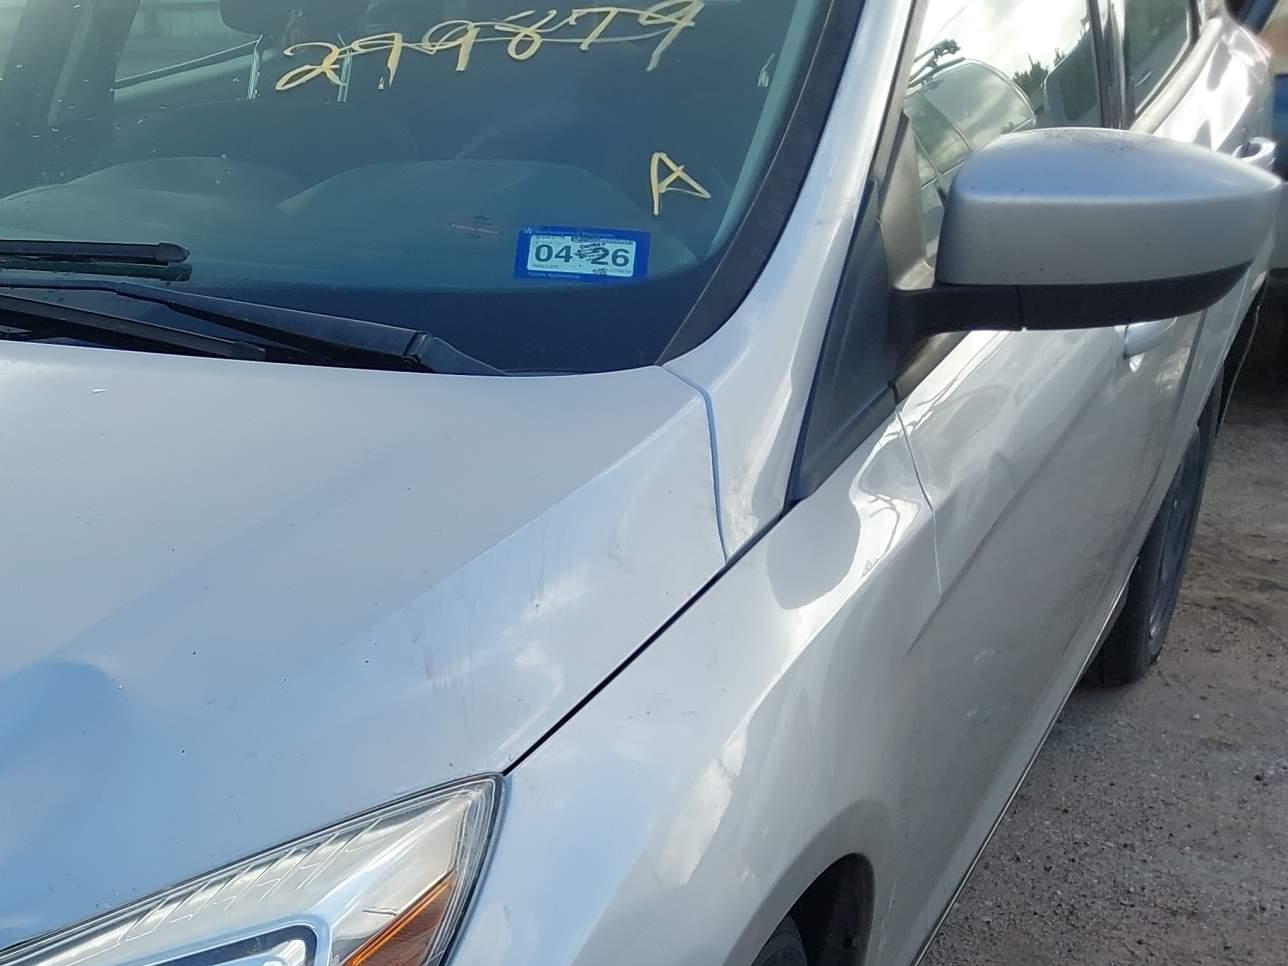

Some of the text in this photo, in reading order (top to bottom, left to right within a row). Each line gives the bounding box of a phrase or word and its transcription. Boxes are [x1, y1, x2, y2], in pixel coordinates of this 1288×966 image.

[275, 0, 708, 91] 299879
[649, 151, 712, 217] A
[534, 243, 630, 267] 04 26
